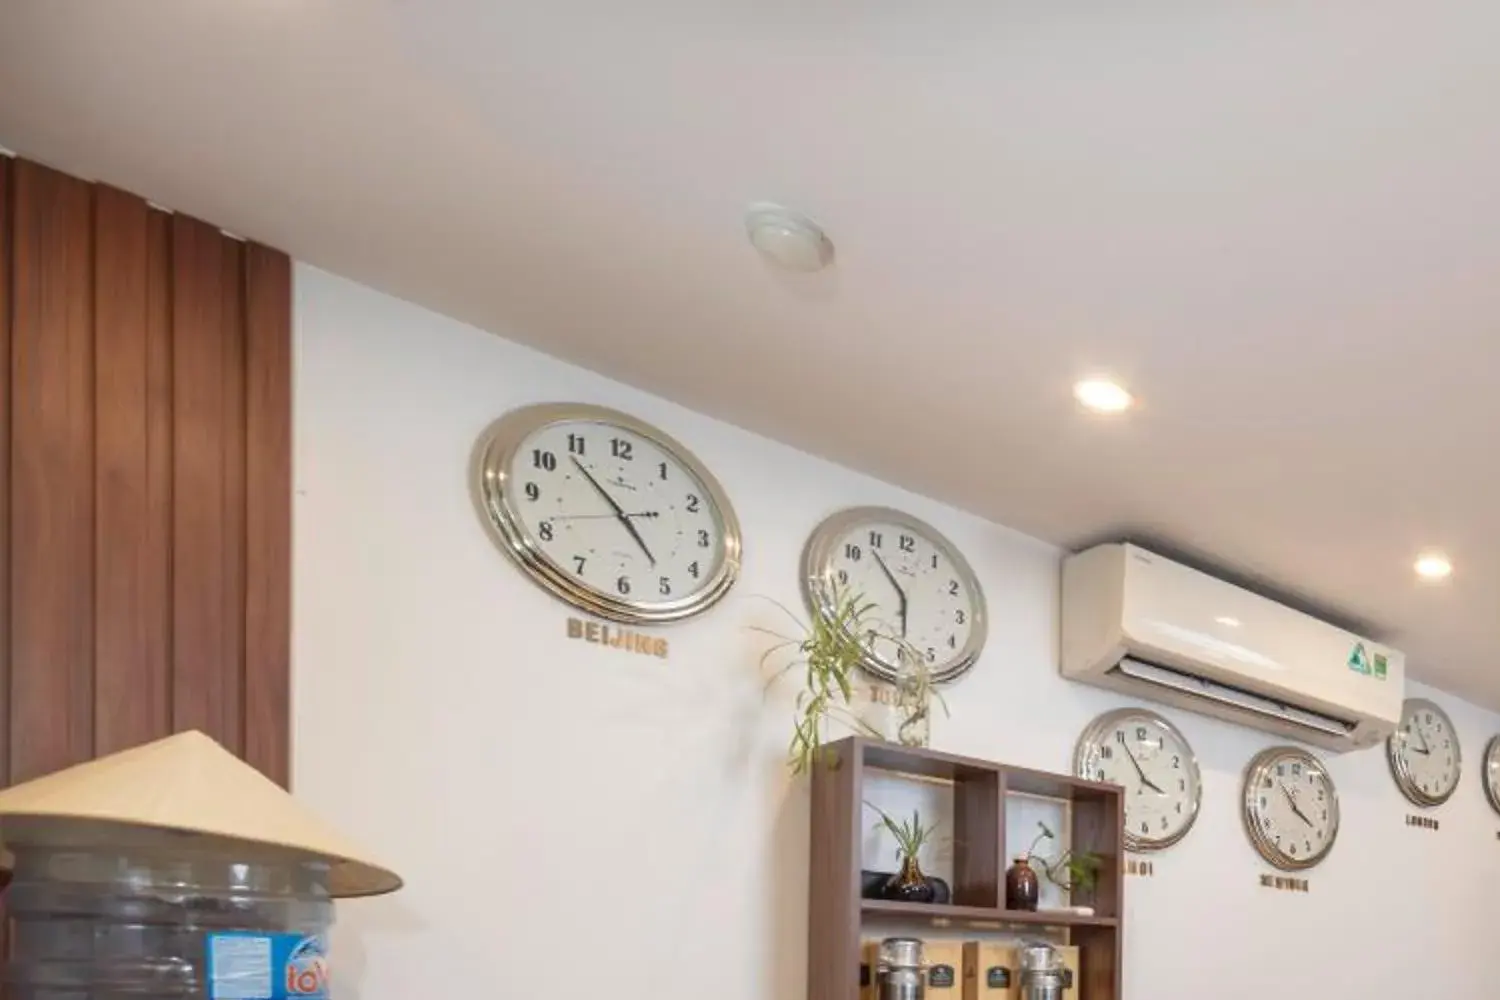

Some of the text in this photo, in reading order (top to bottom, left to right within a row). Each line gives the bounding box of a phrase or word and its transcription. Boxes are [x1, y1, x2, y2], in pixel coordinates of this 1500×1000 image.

[568, 433, 585, 455] 11
[610, 438, 633, 461] 12
[533, 449, 557, 472] 10
[659, 462, 667, 481] 1
[525, 482, 539, 502] 9
[686, 493, 699, 513] 2
[539, 521, 553, 542] 8
[698, 529, 709, 548] 3
[869, 531, 882, 549] 11
[845, 544, 861, 561] 10
[900, 535, 915, 553] 12
[573, 555, 586, 576] 7
[688, 561, 698, 578] 4
[931, 552, 937, 569] 1
[618, 576, 630, 595] 6
[660, 577, 671, 595] 5
[839, 570, 848, 585] 9
[949, 580, 958, 596] 2
[955, 610, 965, 624] 3
